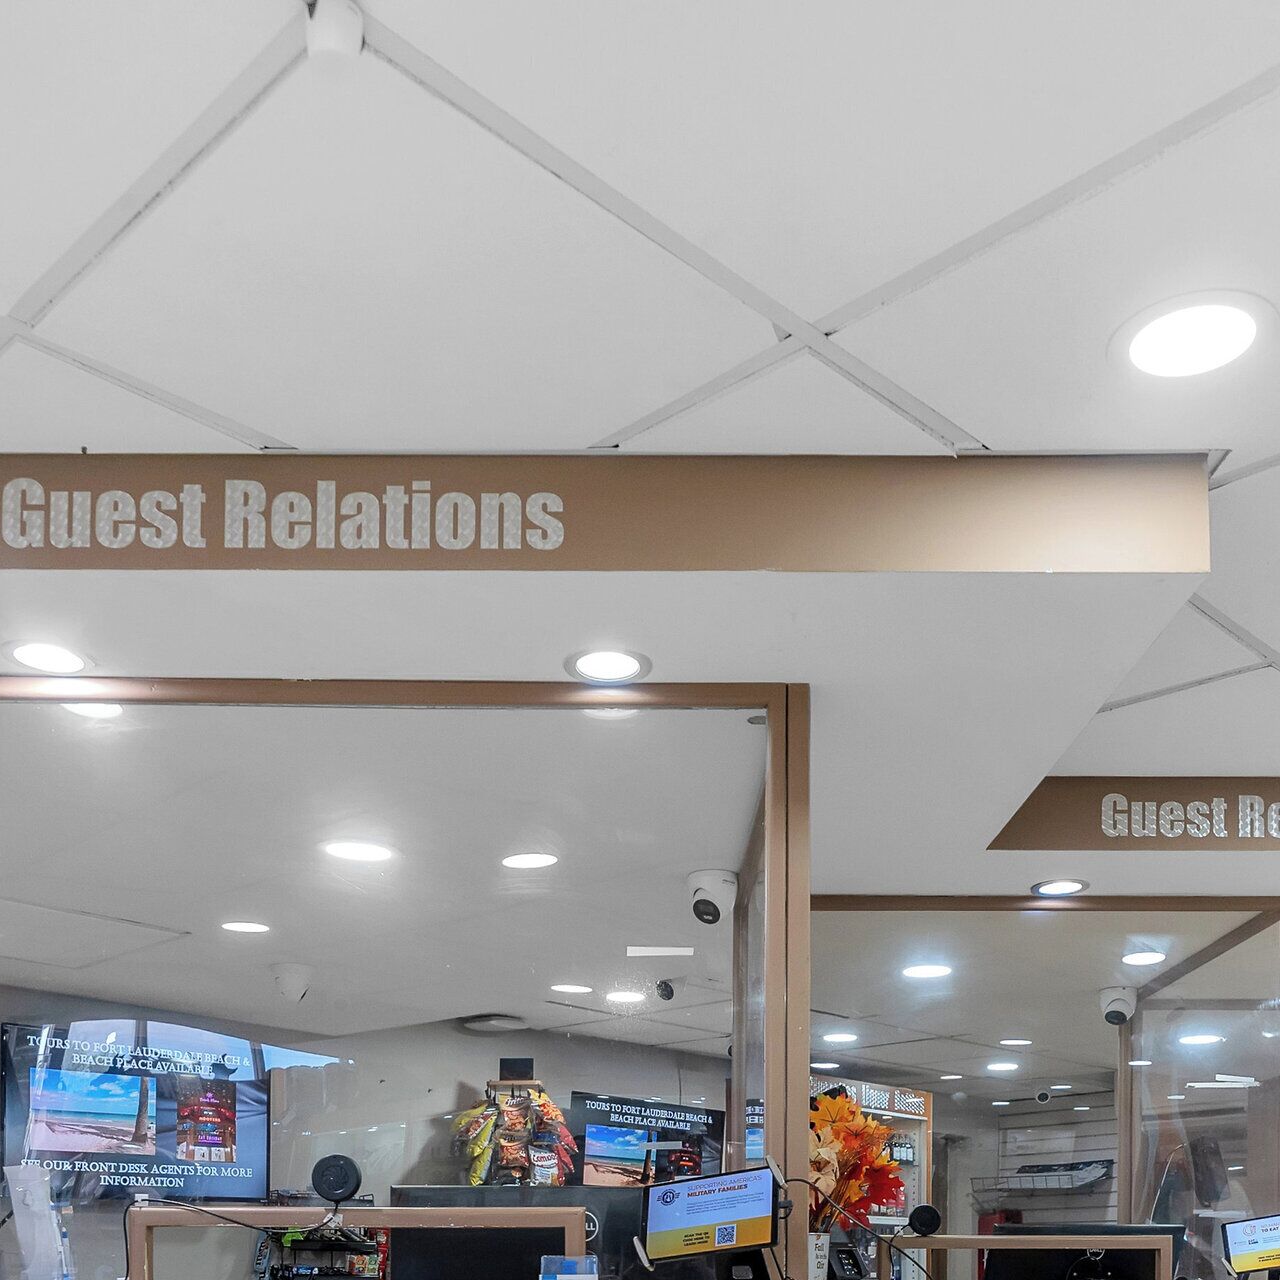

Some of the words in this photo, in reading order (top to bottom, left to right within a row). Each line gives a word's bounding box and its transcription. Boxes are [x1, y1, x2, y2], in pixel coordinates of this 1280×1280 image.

[1, 477, 207, 549] Guest
[223, 480, 565, 551] Relations
[1100, 793, 1228, 838] Guest
[27, 1035, 70, 1050] TOURS
[72, 1039, 90, 1051] TO
[93, 1042, 125, 1055] FORT
[126, 1045, 203, 1064] LAUDERDALE
[203, 1052, 241, 1066] BEACH
[243, 1057, 251, 1067] &
[72, 1053, 113, 1068] BEACH
[115, 1057, 154, 1071] PLACE
[154, 1061, 213, 1076] AVAILABLE
[585, 1100, 610, 1111] TOURS
[612, 1104, 621, 1112] TO
[622, 1105, 641, 1114] FORT
[641, 1108, 685, 1120] LAUDERDALE
[686, 1113, 707, 1123] BEACH
[610, 1113, 634, 1124] BEACH
[635, 1116, 657, 1126] PLACE
[657, 1119, 691, 1131] AVAILABLE
[43, 1159, 73, 1171] OUR
[75, 1160, 117, 1173] FRONT
[120, 1162, 149, 1174] DESK
[151, 1163, 195, 1176] AGENTS
[197, 1164, 219, 1176] FOR
[221, 1166, 253, 1178] MORE
[99, 1175, 185, 1188] INFORMATION
[687, 1180, 729, 1192] SUPPORTING
[687, 1189, 717, 1198] MILITARY
[718, 1184, 748, 1194] FAMILIES
